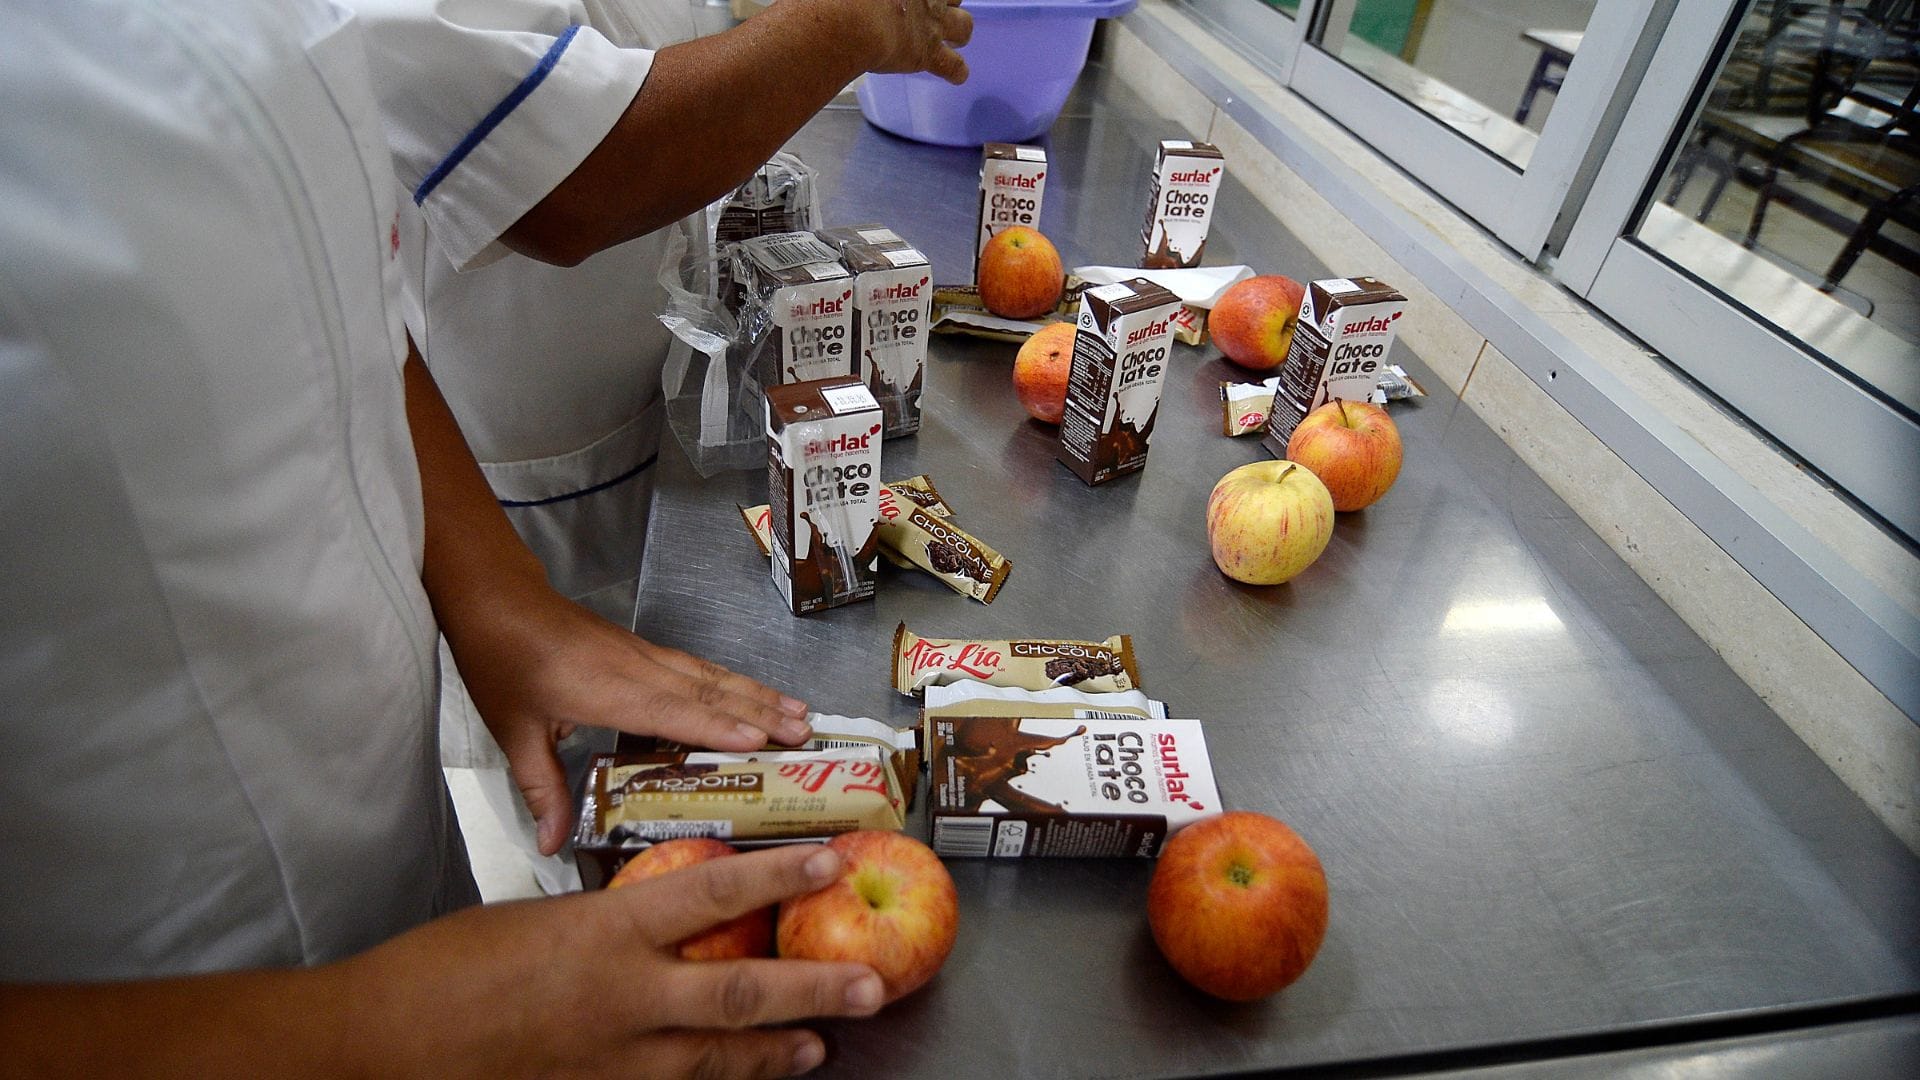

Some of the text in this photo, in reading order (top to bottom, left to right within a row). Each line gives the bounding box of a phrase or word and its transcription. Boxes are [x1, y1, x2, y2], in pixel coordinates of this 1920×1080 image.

[994, 174, 1037, 188] surlat
[1170, 169, 1212, 183] surlat
[991, 194, 1036, 211] Choco
[1166, 190, 1209, 205] Choco
[991, 209, 1033, 224] late
[1164, 204, 1205, 218] late
[867, 308, 919, 329] Choco
[1342, 316, 1391, 335] surlat
[789, 325, 845, 345] Choco
[869, 324, 917, 345] late
[1126, 320, 1169, 345] surlat
[791, 341, 844, 362] late
[1121, 347, 1166, 371] Choco
[1334, 343, 1384, 361] Choco
[1118, 364, 1161, 387] late
[1329, 358, 1377, 377] late
[804, 433, 870, 457] surlat
[803, 463, 872, 487] Choco
[806, 481, 870, 506] late
[914, 514, 994, 579] CHOCOLATE
[904, 638, 1002, 680] Tía Lía
[1014, 644, 1121, 668] CHOCOLATE
[778, 759, 847, 793] Lía
[1093, 733, 1122, 801] late
[1117, 731, 1149, 804] Choco
[1158, 733, 1192, 802] surlat
